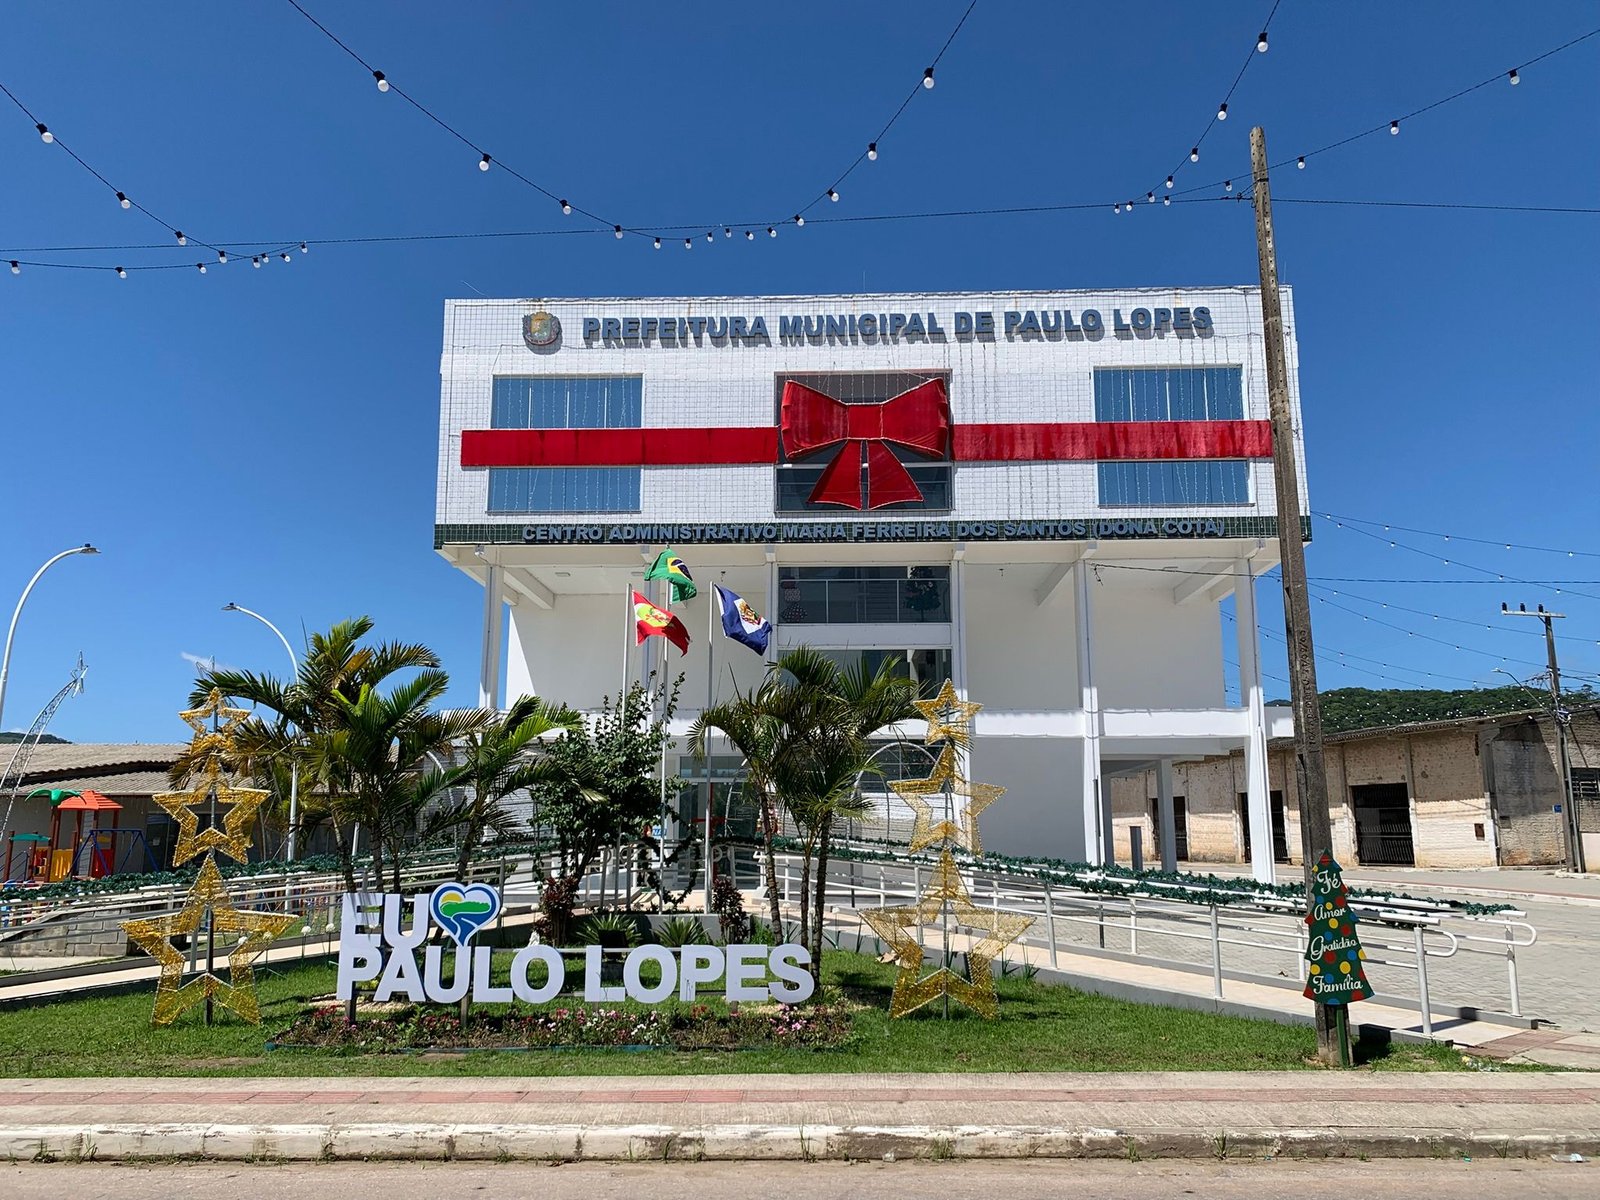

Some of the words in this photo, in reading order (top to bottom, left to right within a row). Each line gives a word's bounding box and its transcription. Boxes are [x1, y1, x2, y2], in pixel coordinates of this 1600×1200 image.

[583, 315, 768, 339] PREFEITURA
[779, 311, 944, 337] MUNICIPAL
[954, 310, 995, 334] DE
[1004, 309, 1101, 333] PAULO
[1113, 306, 1213, 331] LOPES
[522, 526, 601, 541] CENTRO
[608, 525, 777, 541] ADMINISTRATIVO
[782, 524, 846, 539] MARIA
[852, 523, 950, 538] FERREIRA
[957, 522, 998, 537] DOS
[1004, 521, 1086, 537] SANTOS
[1092, 520, 1157, 537] (DONA
[1163, 519, 1225, 537] COTA)
[1317, 870, 1341, 894] Fé
[338, 893, 431, 948] EU
[1314, 904, 1346, 921] Amor
[1311, 936, 1358, 961] Gratidão
[336, 944, 566, 1004] PAULO
[584, 943, 815, 1004] LOPES
[1312, 974, 1363, 995] Família
